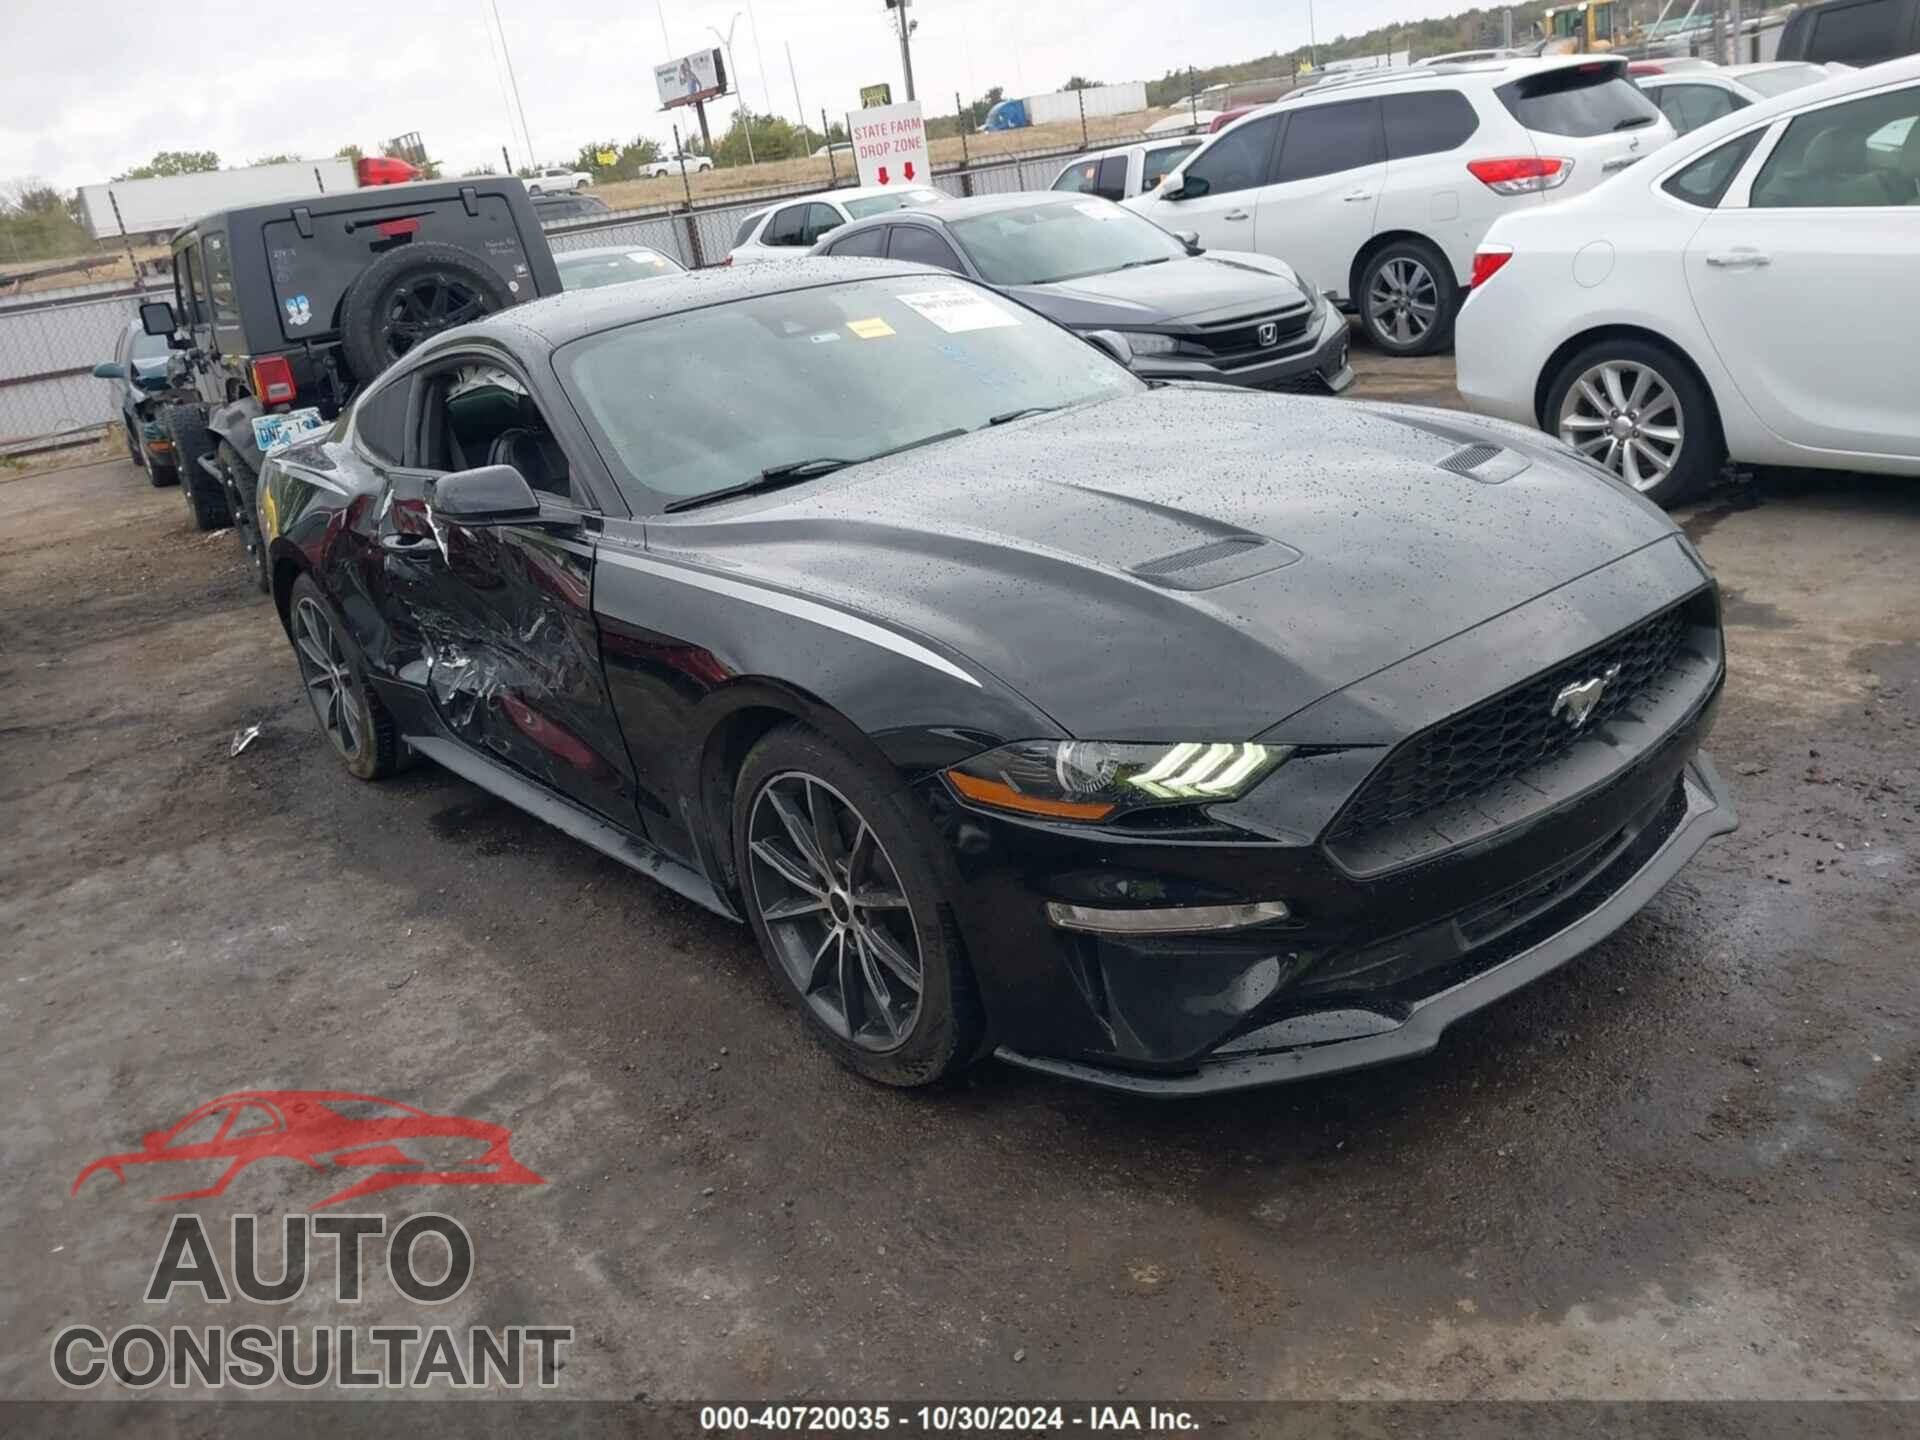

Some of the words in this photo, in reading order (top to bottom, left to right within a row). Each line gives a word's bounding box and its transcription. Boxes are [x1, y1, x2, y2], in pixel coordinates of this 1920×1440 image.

[854, 123, 888, 140] STATE
[890, 117, 922, 134] FARM
[860, 142, 890, 159] DROP
[894, 136, 921, 153] ZONE
